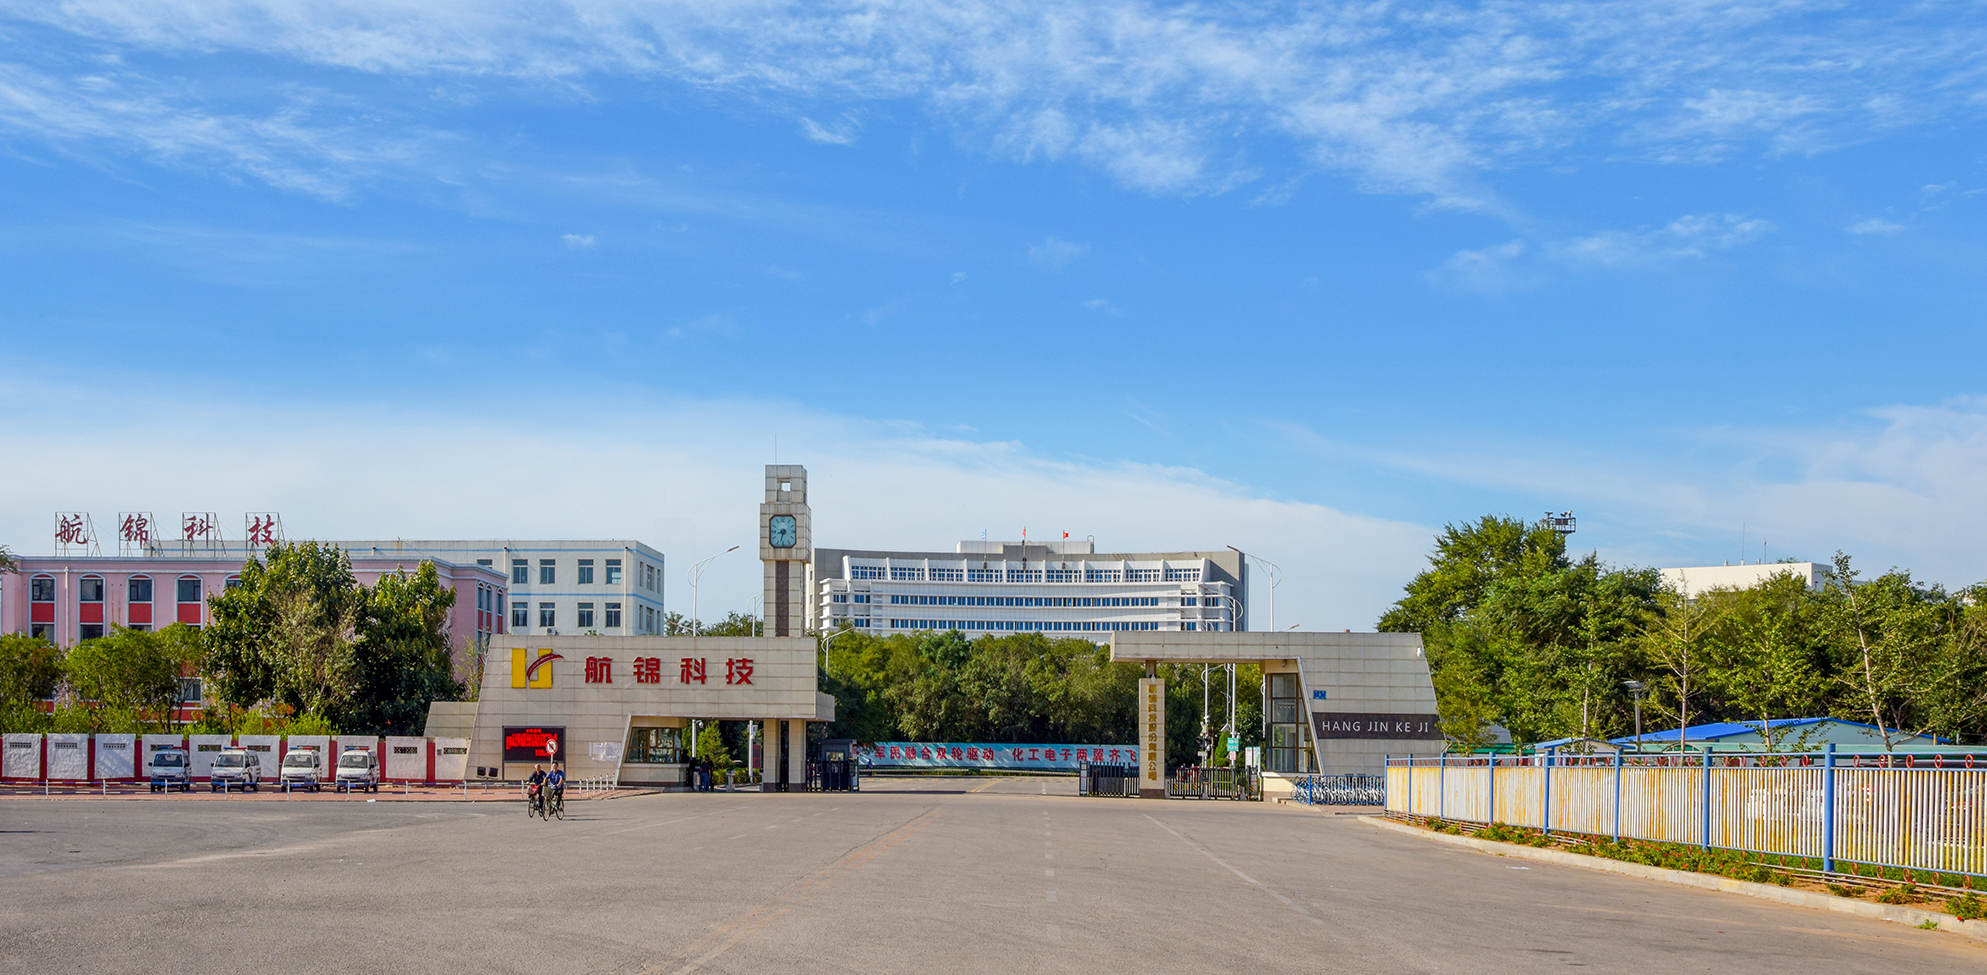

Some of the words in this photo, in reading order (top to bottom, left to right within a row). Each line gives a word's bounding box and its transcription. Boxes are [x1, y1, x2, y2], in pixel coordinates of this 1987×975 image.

[56, 513, 277, 549] 航锦科技
[584, 656, 754, 685] 航锦科技
[1322, 721, 1361, 732] HANG
[1367, 721, 1389, 732] JIN
[1395, 722, 1411, 732] KE
[1418, 722, 1429, 733] JI
[874, 745, 995, 761] 军民融合双轮驱动
[1012, 747, 1137, 763] 化工电子两翼齐飞
